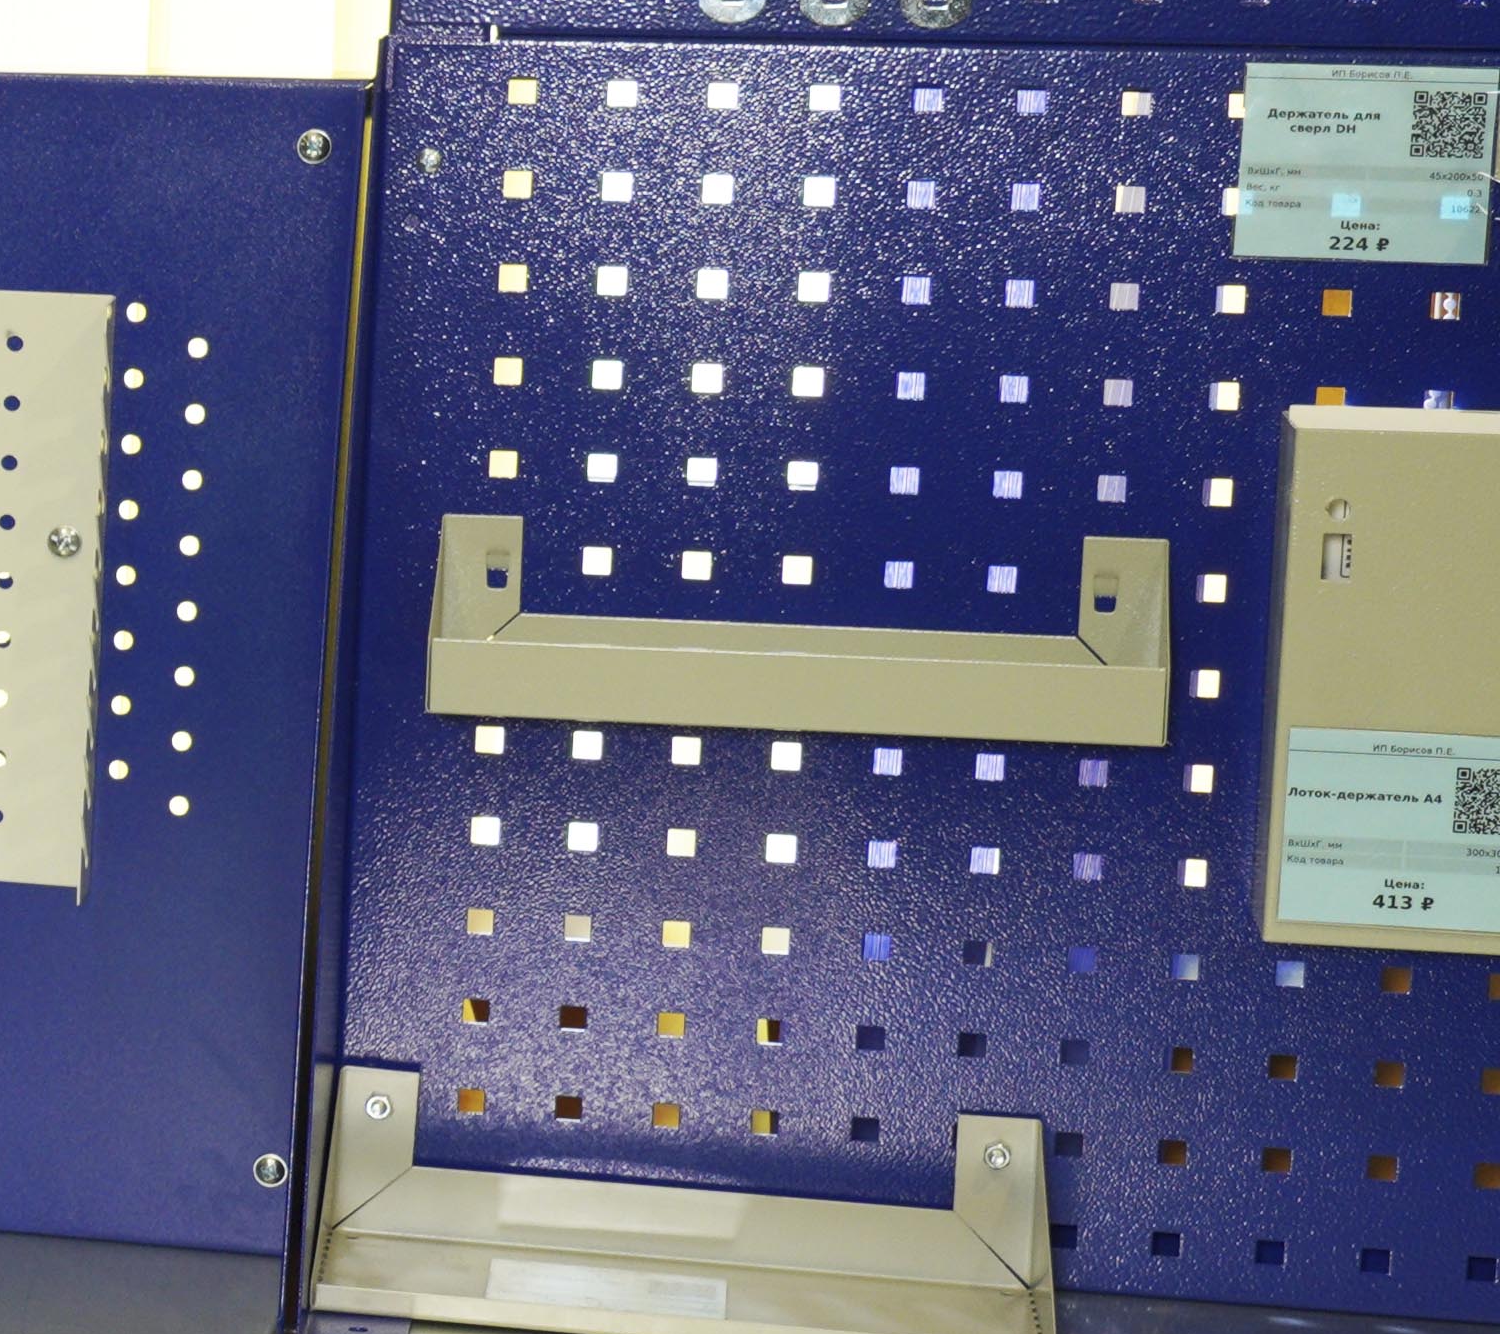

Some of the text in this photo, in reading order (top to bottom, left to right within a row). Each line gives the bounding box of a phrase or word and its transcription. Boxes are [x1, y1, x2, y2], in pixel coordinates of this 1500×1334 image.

[1331, 69, 1347, 79] ИП
[1349, 70, 1391, 81] Борисов
[1267, 108, 1381, 122] Держатель для
[1290, 124, 1331, 135] сверл
[1267, 200, 1302, 210] товара
[1340, 220, 1381, 232] Цена:
[1329, 235, 1369, 251] 224
[1372, 744, 1388, 753] ИП
[1390, 745, 1433, 756] Борисов
[1287, 786, 1419, 804] Лоток-держатель
[1286, 855, 1307, 865] Код
[1309, 857, 1345, 867] товара
[1384, 878, 1425, 891] Цена:
[1372, 894, 1413, 911] 413
